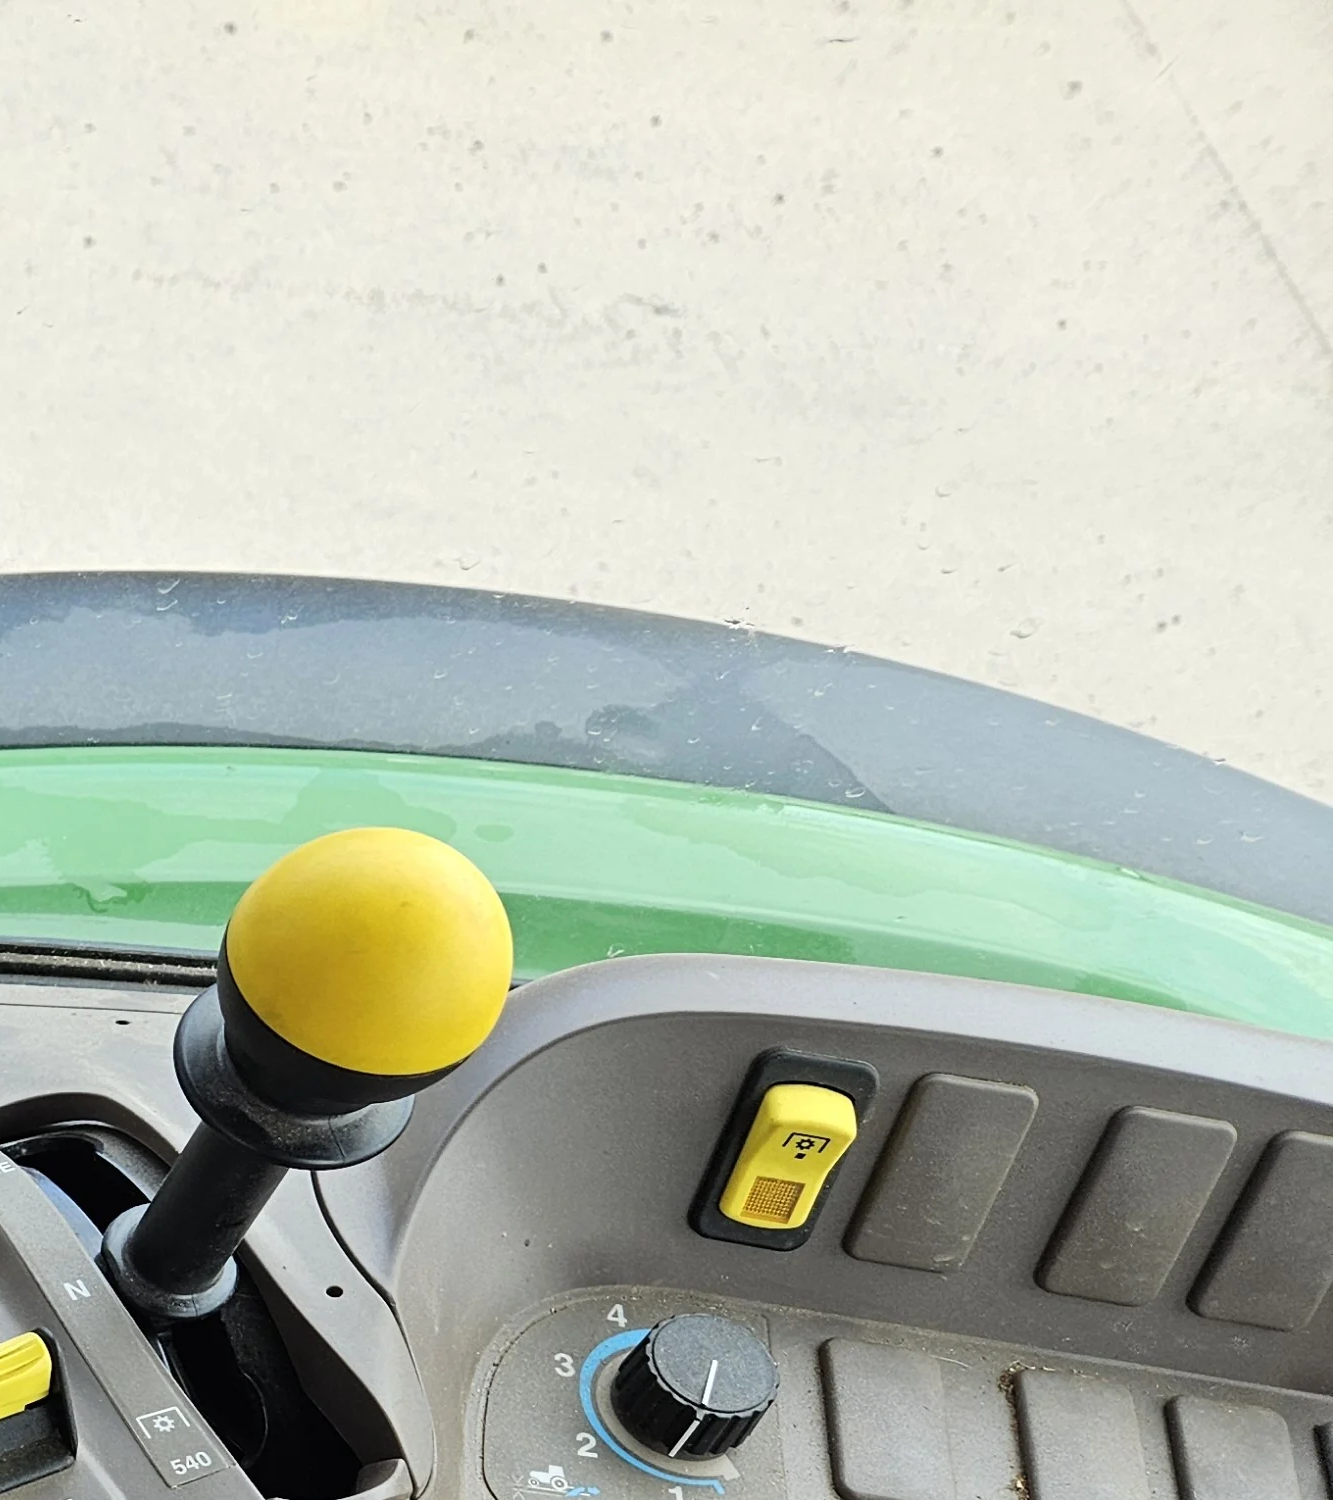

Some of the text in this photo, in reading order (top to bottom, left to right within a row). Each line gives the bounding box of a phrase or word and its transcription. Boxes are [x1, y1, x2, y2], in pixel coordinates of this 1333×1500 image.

[63, 1279, 92, 1301] N
[607, 1304, 627, 1327] 4
[554, 1353, 576, 1378] 3
[576, 1433, 598, 1458] 2
[170, 1451, 212, 1475] 540
